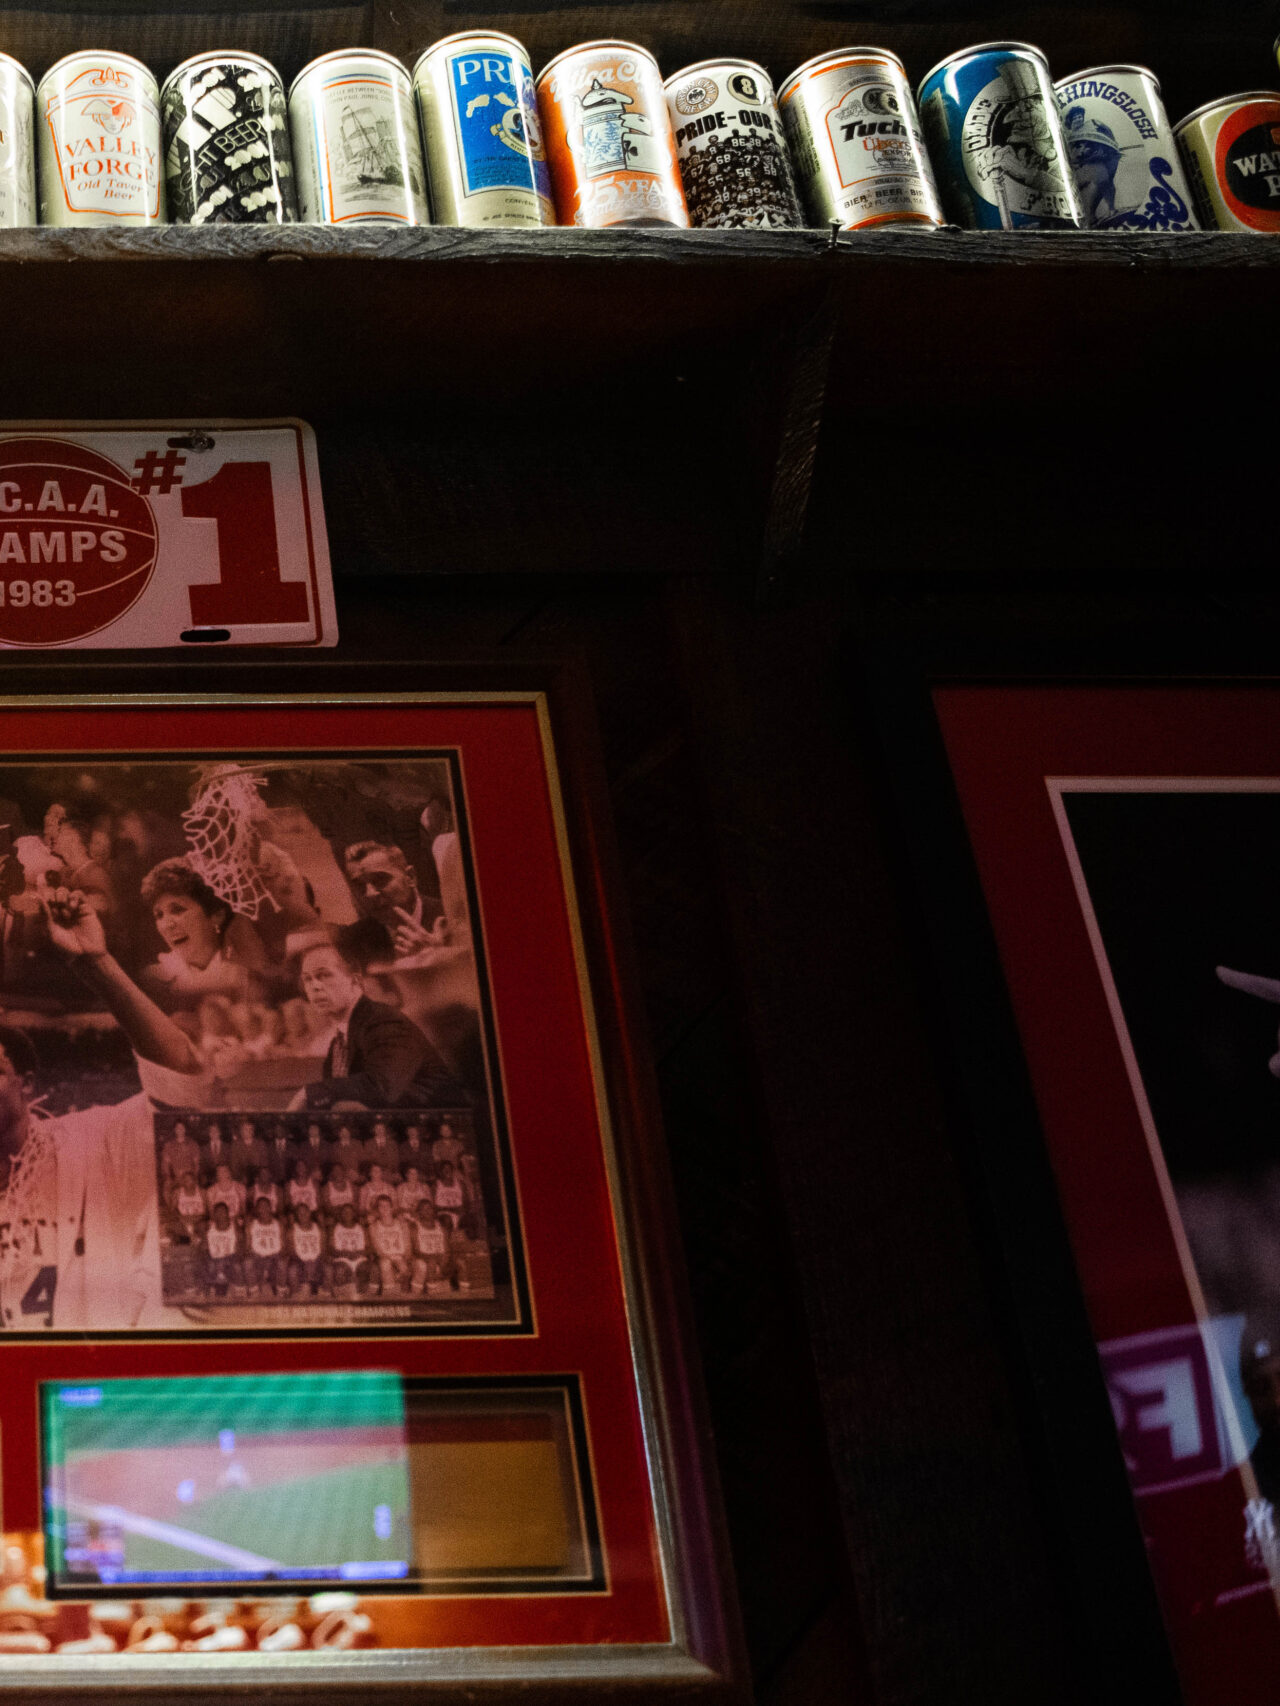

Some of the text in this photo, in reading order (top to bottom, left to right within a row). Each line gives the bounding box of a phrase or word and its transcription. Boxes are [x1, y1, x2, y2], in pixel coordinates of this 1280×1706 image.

[740, 77, 754, 95] 8
[1057, 80, 1159, 141] THINGSLOSH
[213, 118, 267, 154] BEER
[840, 119, 919, 143] Tuch
[1232, 151, 1280, 177] WAT
[107, 177, 145, 194] Taver
